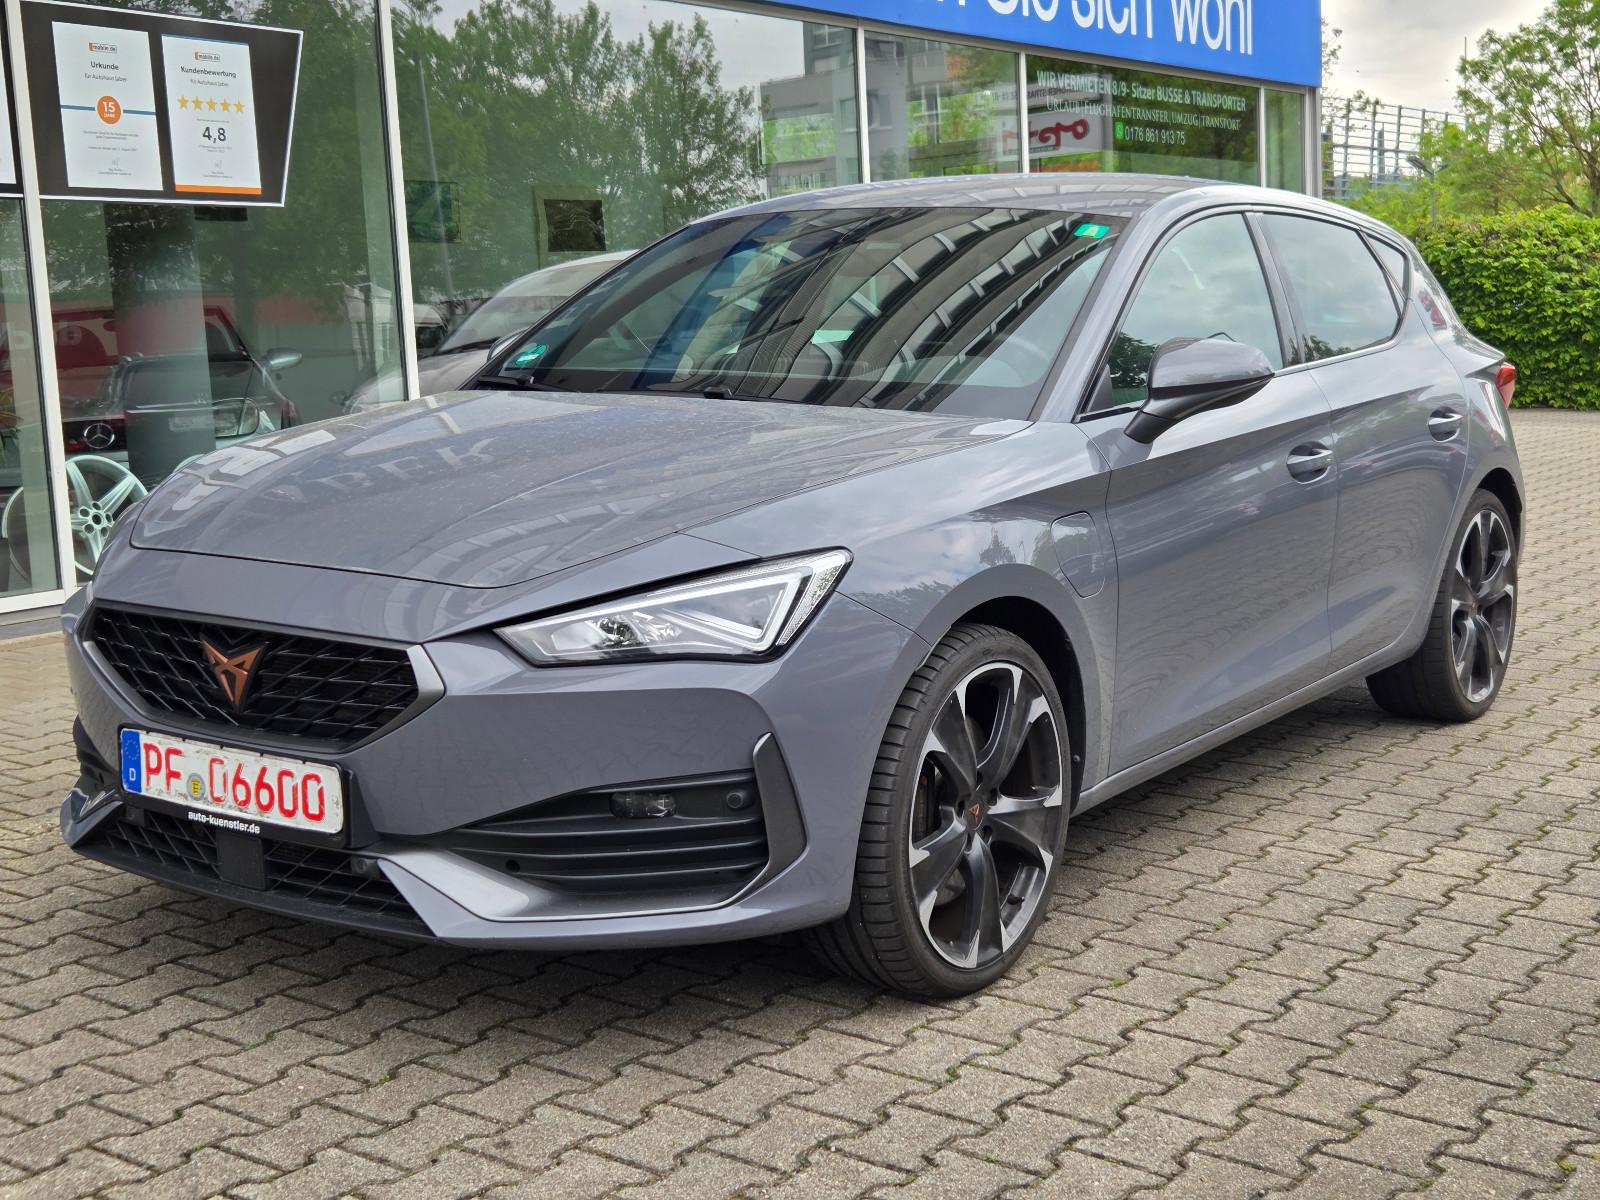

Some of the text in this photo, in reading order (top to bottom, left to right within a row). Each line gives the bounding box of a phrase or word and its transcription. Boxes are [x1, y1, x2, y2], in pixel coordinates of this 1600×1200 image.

[1171, 0, 1253, 55] wohl
[90, 60, 119, 70] Urkunde
[180, 65, 237, 79] Kundenbewertung
[1036, 70, 1056, 88] WIR
[1057, 72, 1111, 95] VERMIETEN
[1131, 82, 1156, 100] Sitzer
[1156, 86, 1183, 104] BUSSE
[1184, 90, 1191, 105] &
[1191, 91, 1246, 111] TRANSPORTER
[102, 101, 116, 113] 15
[202, 126, 227, 144] 4,8
[1125, 126, 1186, 145] 0176 861 913 75
[129, 768, 136, 781] D
[142, 742, 326, 823] PF 06600
[187, 810, 261, 834] auto-kuenstler.de
